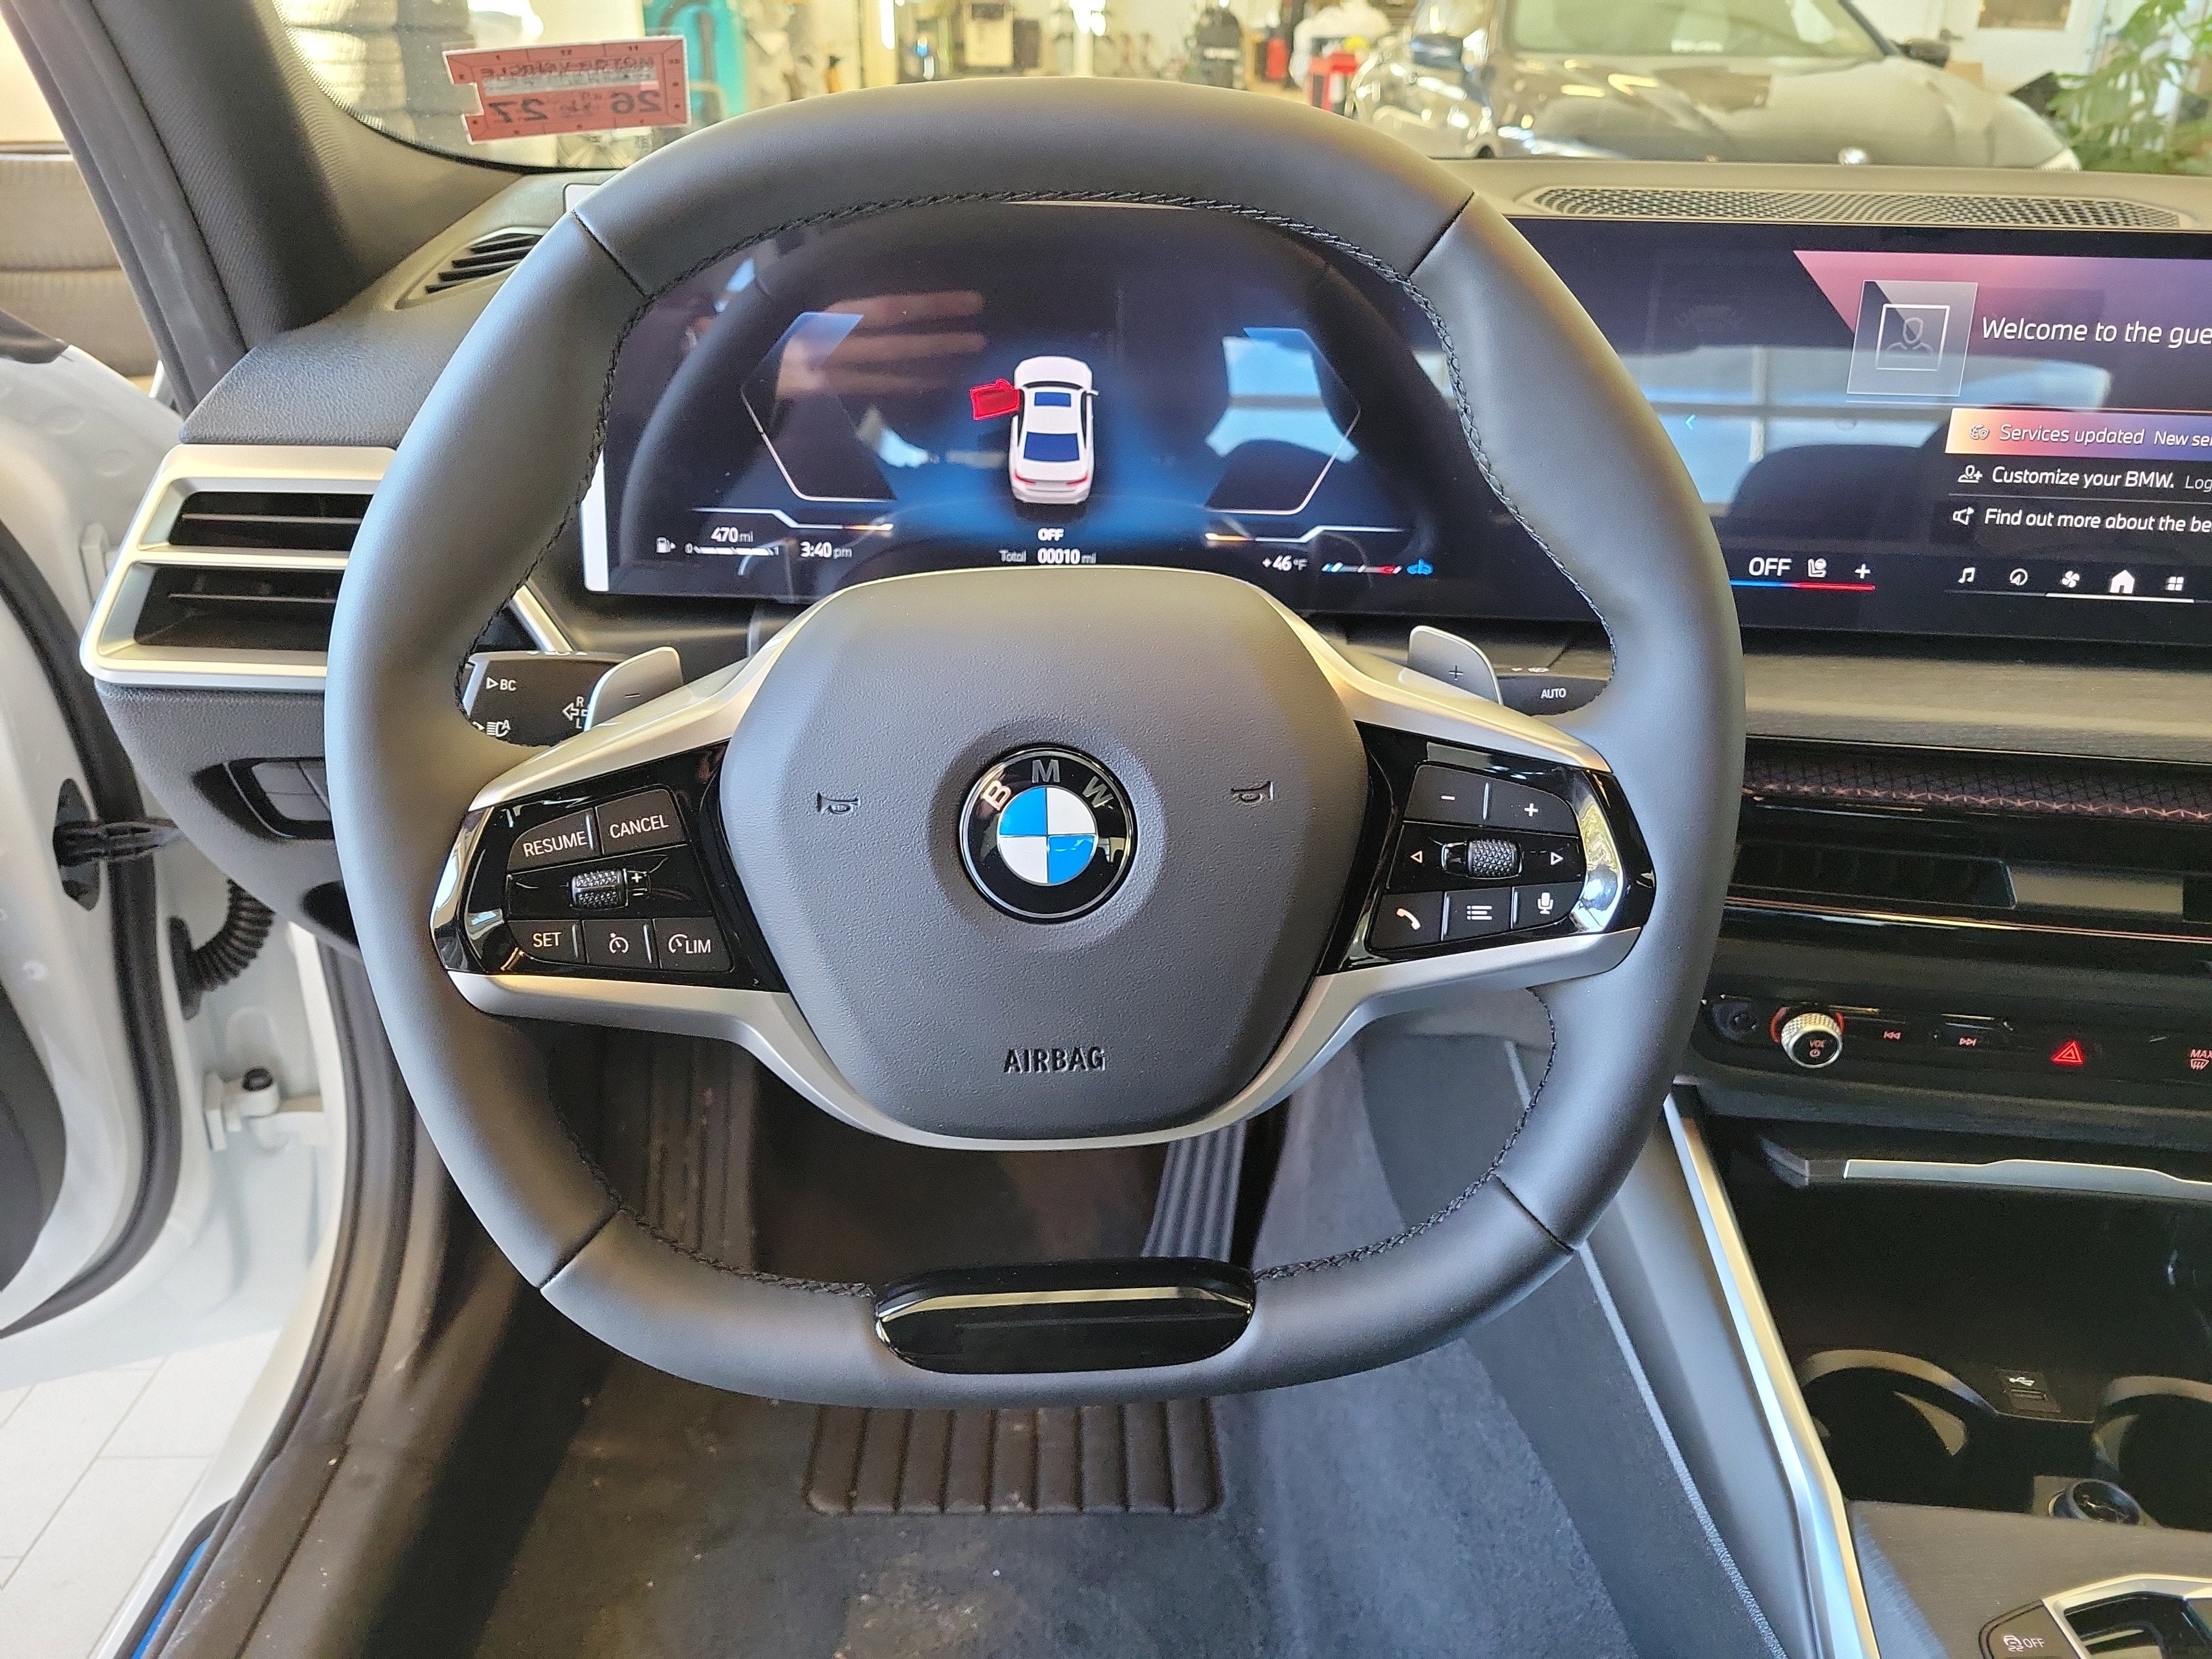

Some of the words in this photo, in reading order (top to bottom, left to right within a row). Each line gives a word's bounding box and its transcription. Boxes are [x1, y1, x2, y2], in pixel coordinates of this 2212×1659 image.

[1982, 316, 2088, 342] Welcome
[2094, 321, 2118, 342] to
[2124, 320, 2162, 343] the
[1999, 424, 2069, 443] Services
[2074, 427, 2145, 446] updated
[2153, 431, 2189, 445] New
[1991, 466, 2080, 486] Customize
[2083, 473, 2121, 489] your
[2124, 471, 2175, 489] BMW.
[1984, 508, 2021, 526] Find
[2025, 511, 2054, 527] out
[2056, 515, 2100, 529] more
[2104, 513, 2154, 531] about
[2158, 515, 2186, 532] the
[2190, 516, 2212, 533] be
[710, 526, 738, 543] 470
[1037, 528, 1064, 541] OFF
[800, 541, 832, 558] 3:40
[833, 546, 853, 560] pm
[998, 549, 1027, 563] Total
[1037, 548, 1081, 565] 00010
[1081, 552, 1097, 564] mi
[1748, 556, 1793, 577] OFF
[500, 679, 517, 692] BC
[1541, 687, 1567, 699] AUTO
[575, 696, 585, 708] R
[980, 759, 1114, 811] BMW
[609, 814, 669, 839] CANCEL
[522, 830, 588, 857] RESUME
[532, 932, 562, 948] SET
[685, 939, 711, 954] LIM
[1003, 1046, 1105, 1074] AIRBAG
[2190, 1049, 2212, 1059] MAX
[2023, 1638, 2045, 1648] OFF
